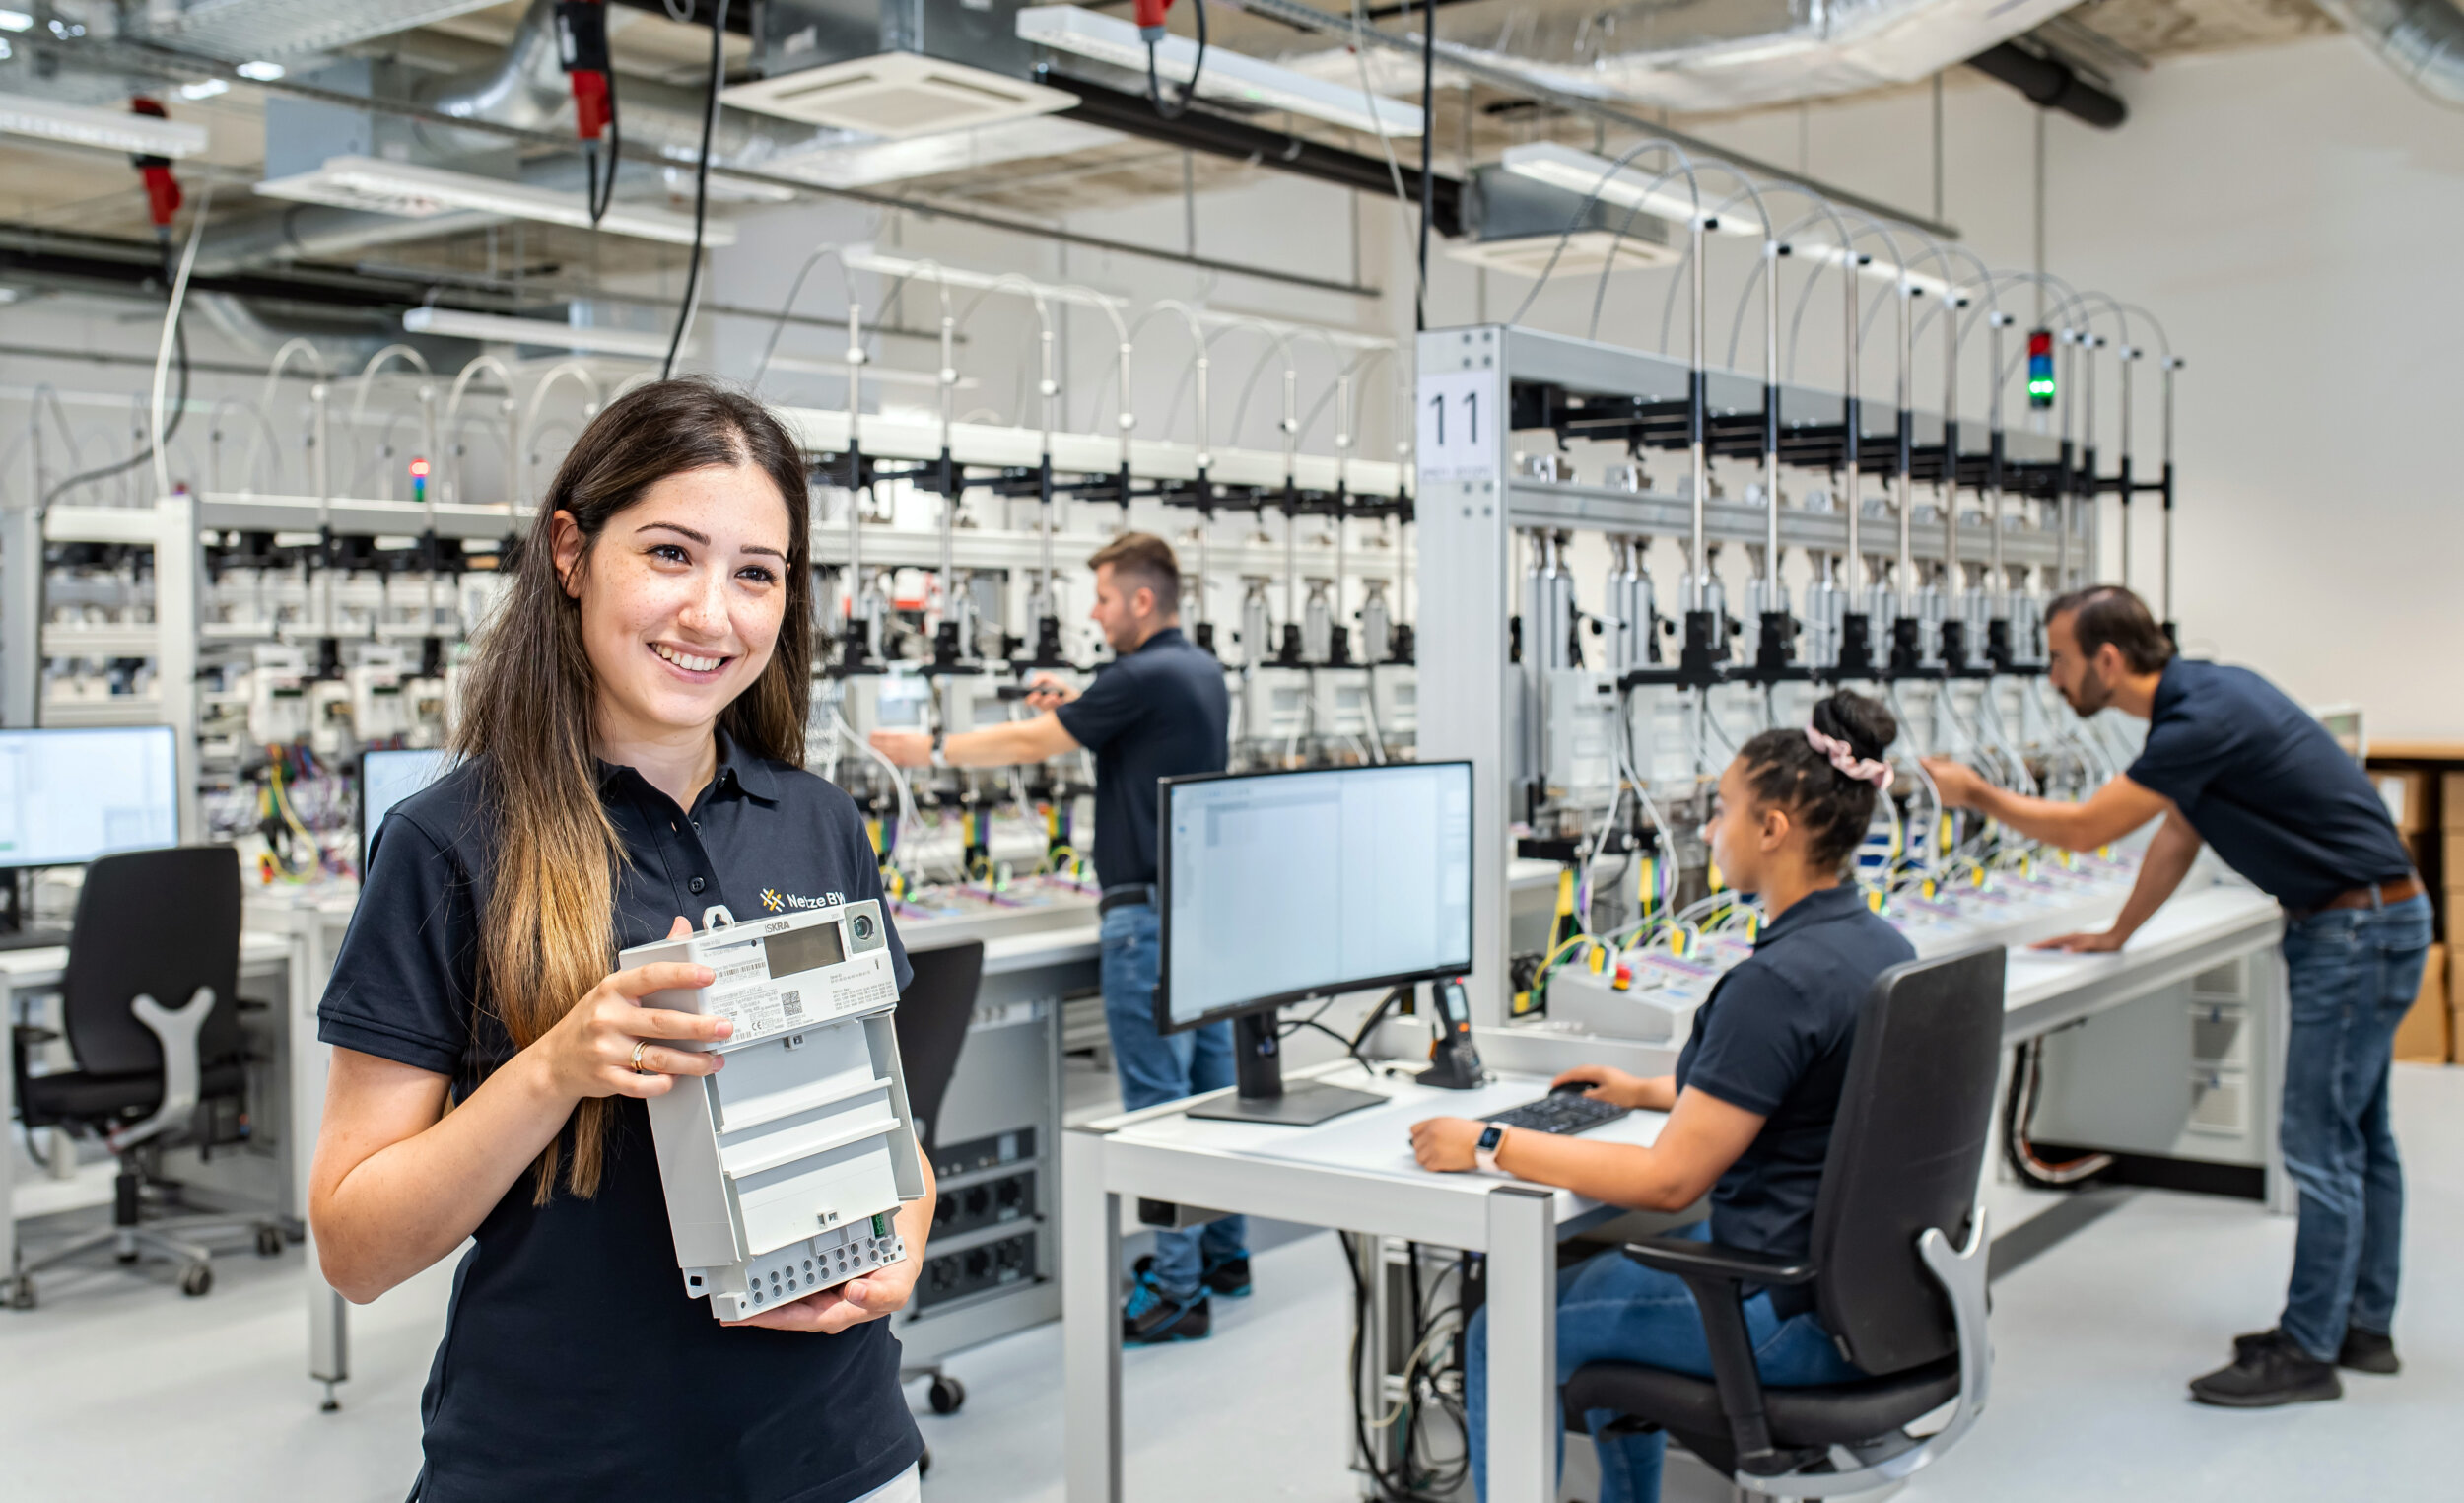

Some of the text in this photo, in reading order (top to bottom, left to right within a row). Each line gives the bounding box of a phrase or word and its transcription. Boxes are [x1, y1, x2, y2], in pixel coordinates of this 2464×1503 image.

[1429, 390, 1477, 445] 11
[787, 893, 826, 908] Netze
[765, 921, 790, 933] ISKRA
